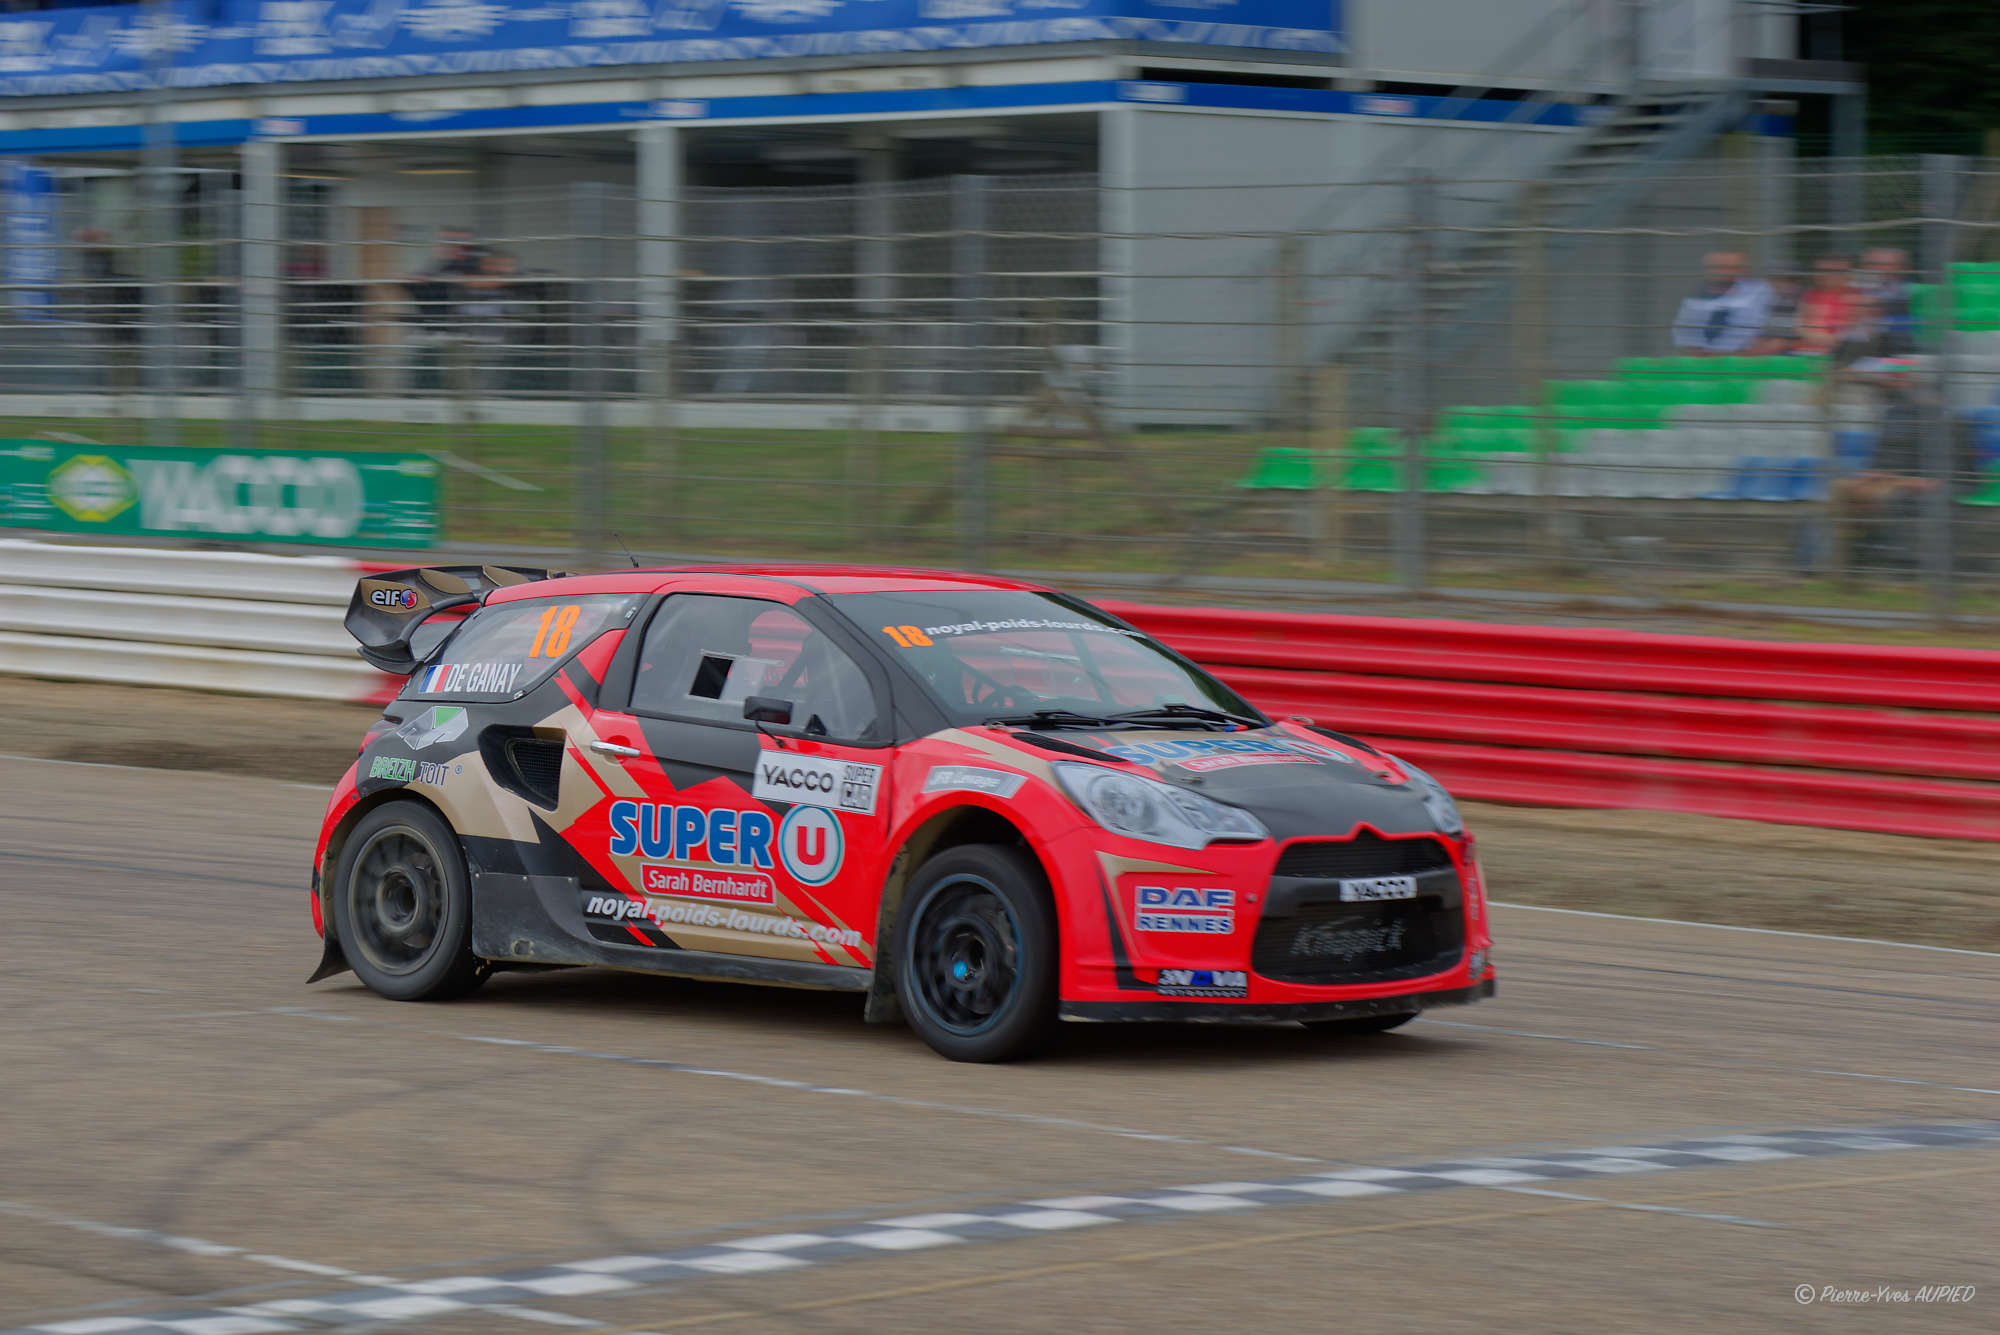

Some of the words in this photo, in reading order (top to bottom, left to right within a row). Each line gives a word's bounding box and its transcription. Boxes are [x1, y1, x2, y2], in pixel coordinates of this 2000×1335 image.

[371, 590, 401, 605] elf
[528, 605, 581, 658] 18
[882, 625, 934, 647] 18
[444, 664, 470, 692] DE
[466, 663, 522, 693] GANAY
[1104, 739, 1297, 766] SUPER
[369, 756, 417, 782] BREIZH
[420, 762, 449, 786] TOIT
[763, 764, 833, 793] YACCO
[609, 801, 774, 868] SUPER
[797, 825, 826, 866] U
[648, 869, 689, 892] Sarah
[692, 873, 768, 899] Bernhardt
[1138, 888, 1233, 907] DAF
[587, 895, 863, 948] noyal-poids-lourds.com
[1137, 916, 1232, 933] RENNES
